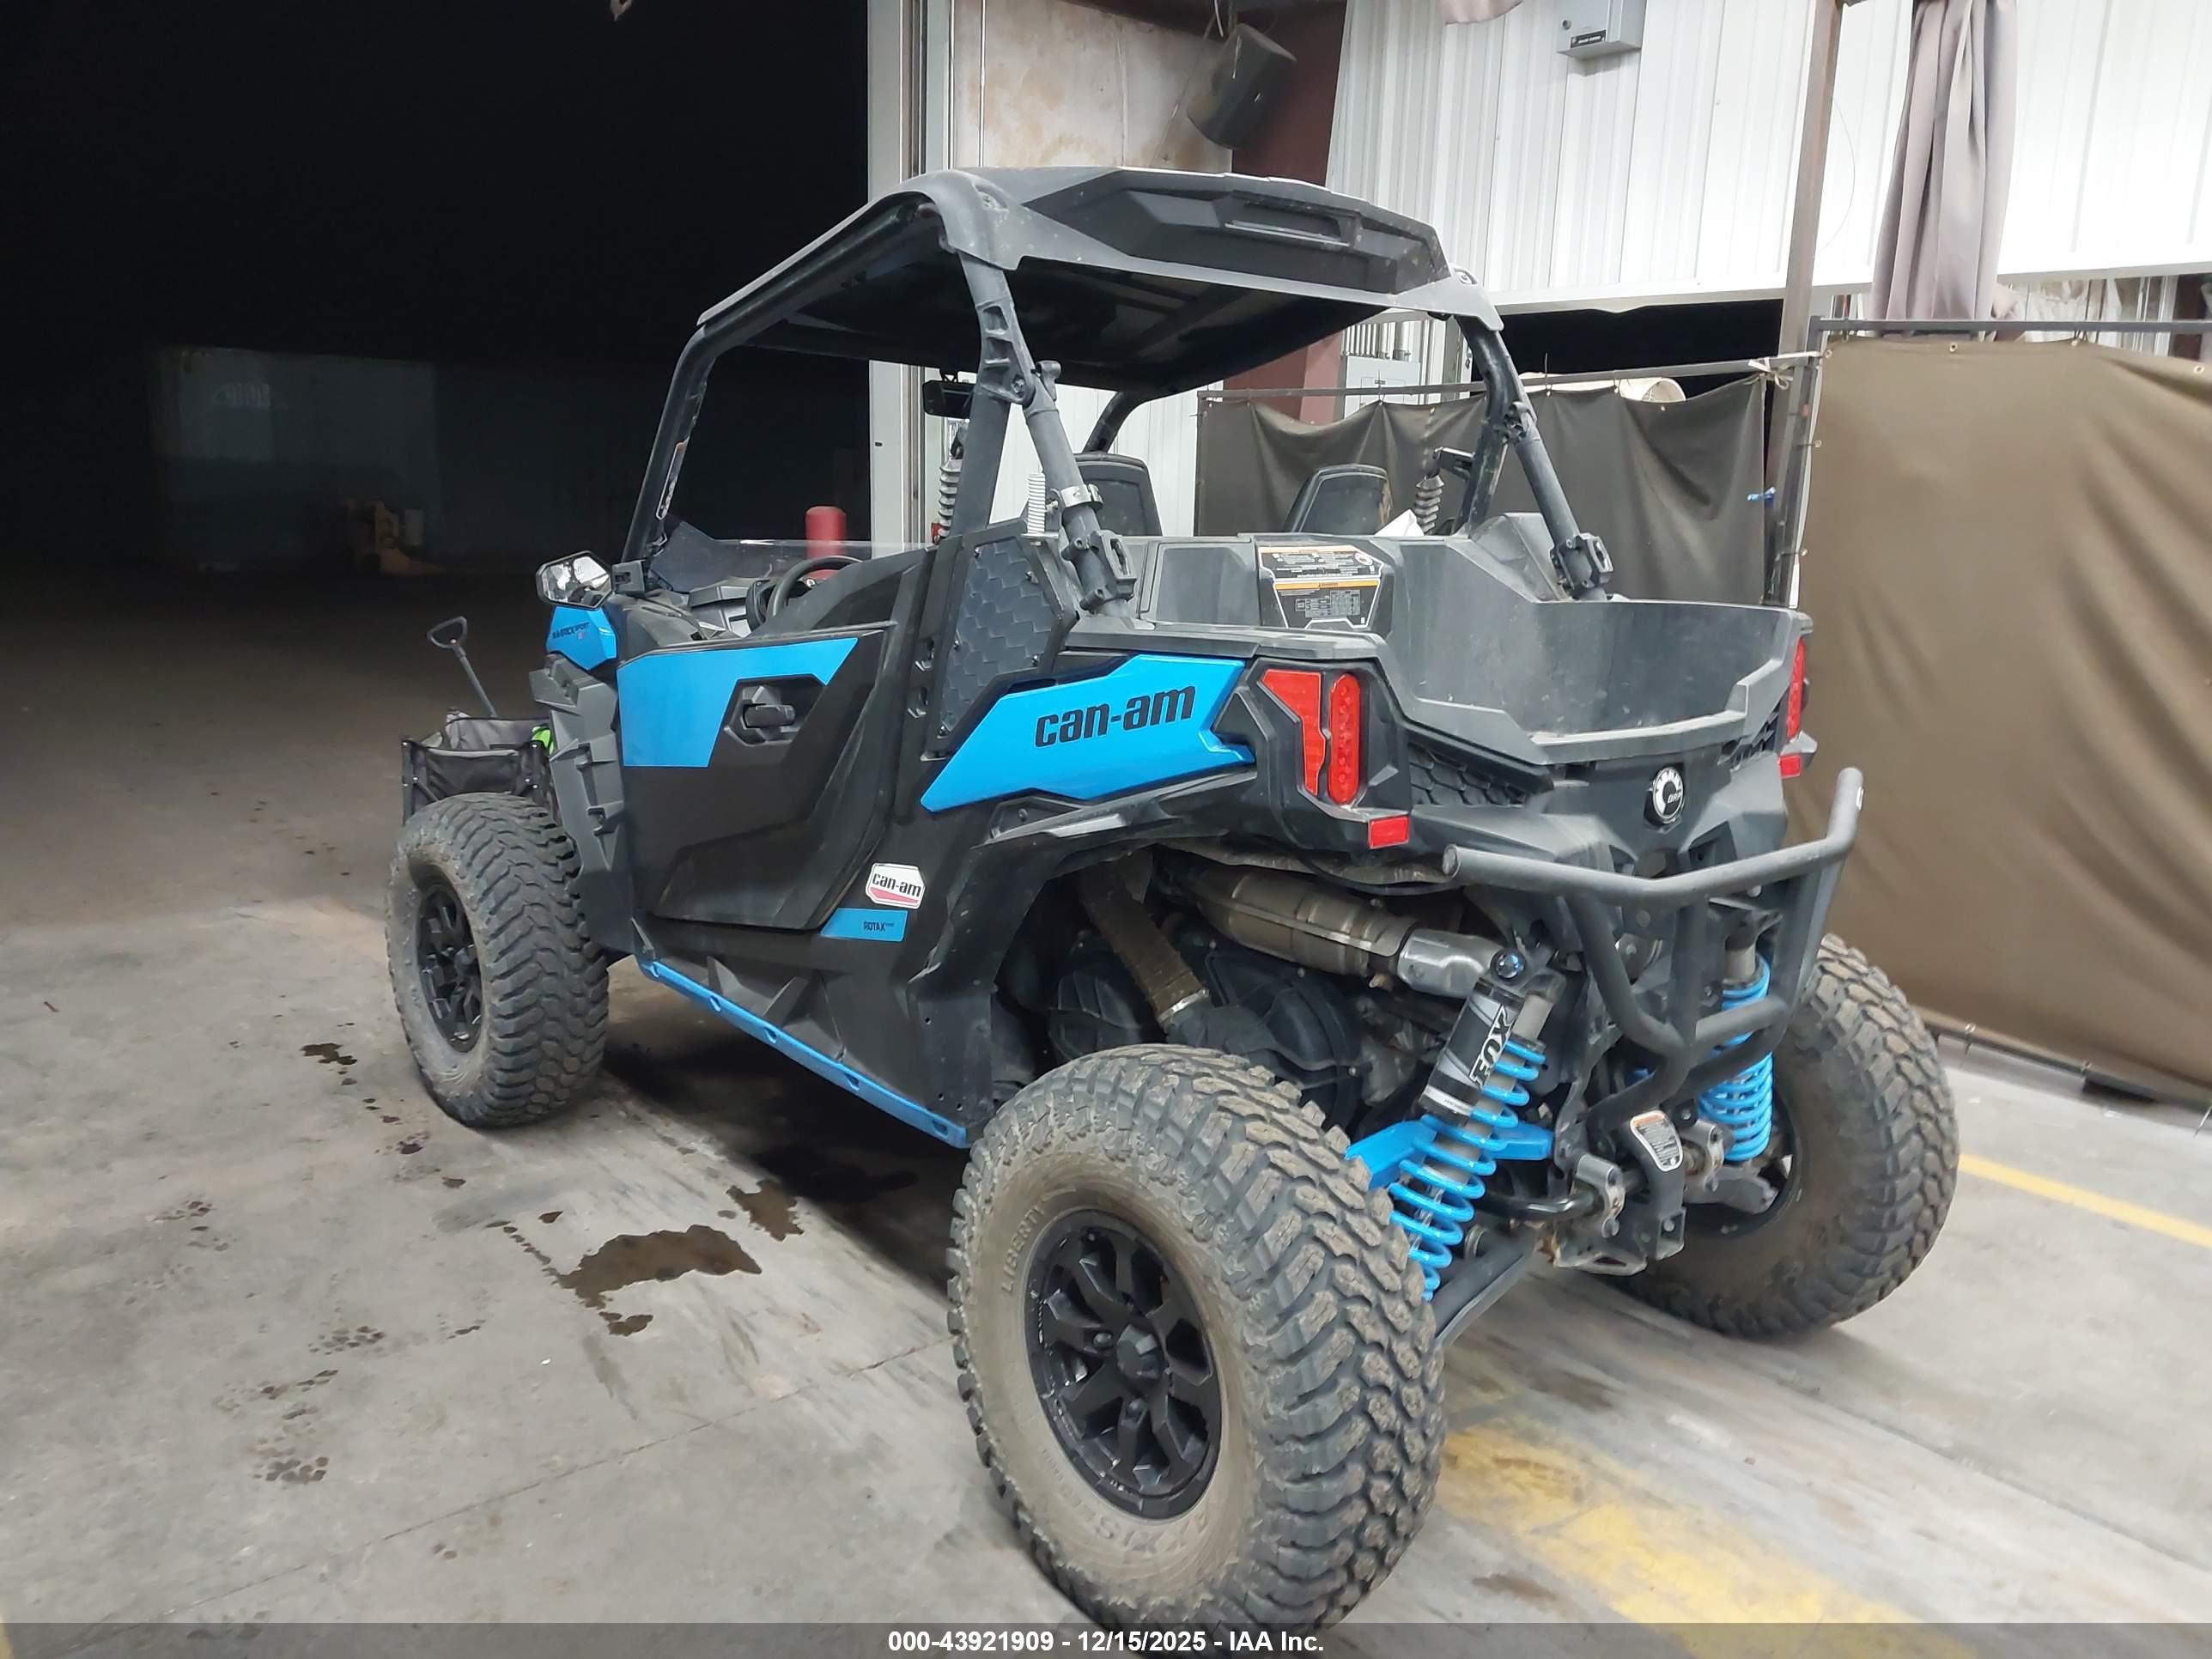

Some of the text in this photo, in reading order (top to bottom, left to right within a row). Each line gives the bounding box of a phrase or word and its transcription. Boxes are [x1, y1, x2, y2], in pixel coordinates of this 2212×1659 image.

[1035, 685, 1196, 747] can-am
[872, 873, 921, 897] can-am
[864, 921, 886, 933] ROTAX
[1468, 1003, 1513, 1086] FOX
[1000, 1201, 1044, 1291] LIBERTY
